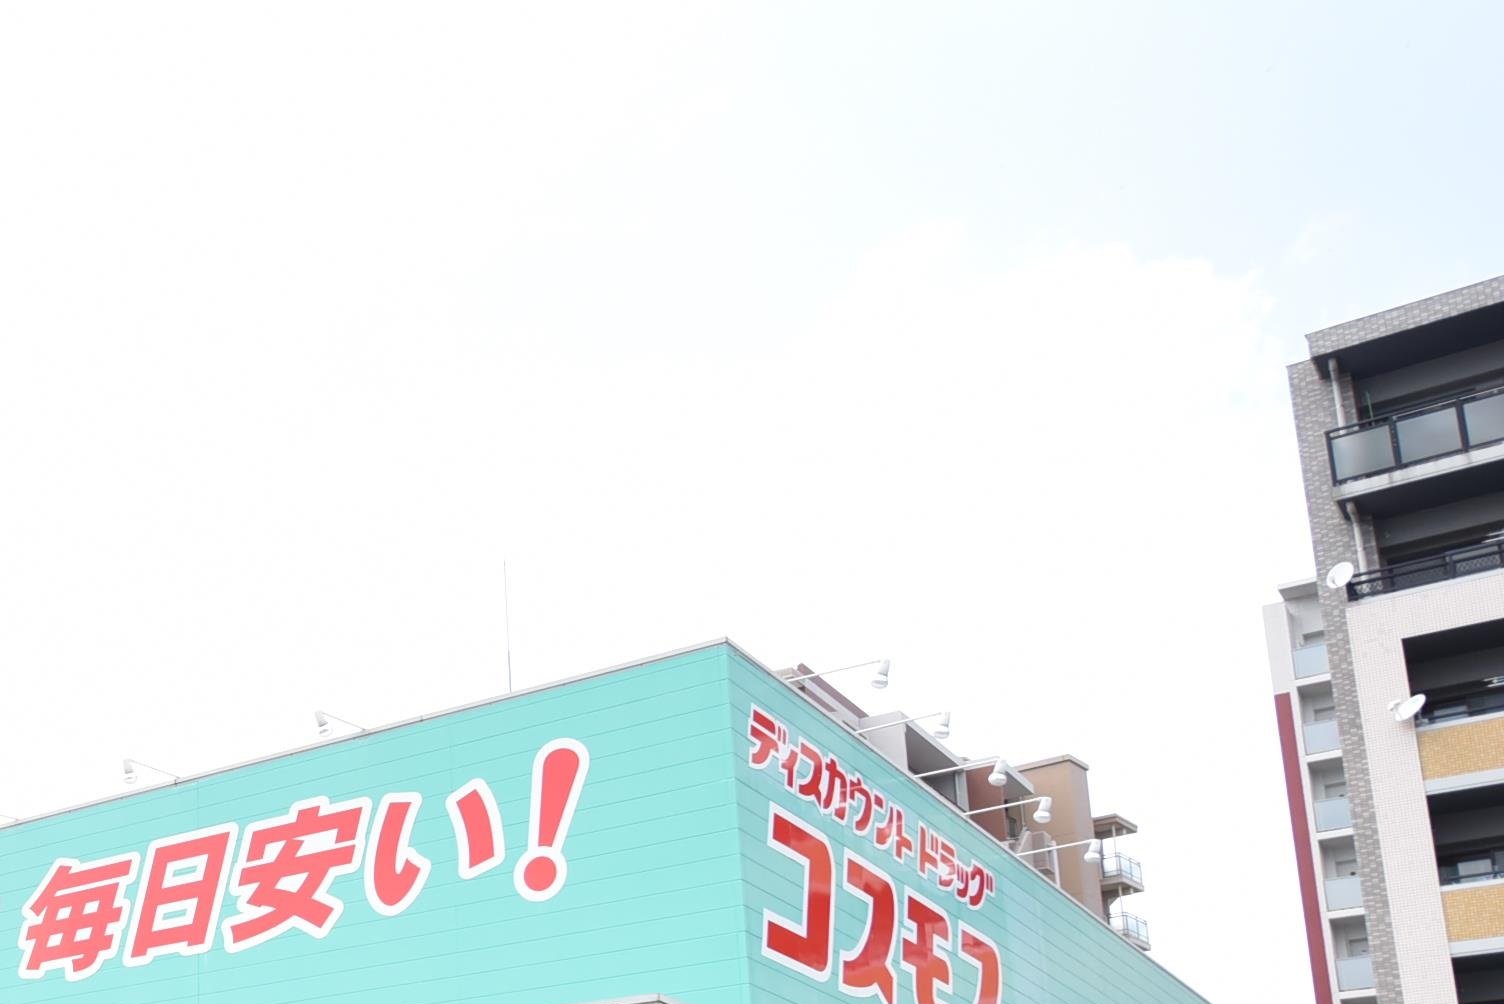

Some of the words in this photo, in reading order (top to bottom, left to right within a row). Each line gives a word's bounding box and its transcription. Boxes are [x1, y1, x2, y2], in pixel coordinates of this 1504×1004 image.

[748, 703, 914, 864] ディスカウント
[918, 820, 995, 908] ドラッグ
